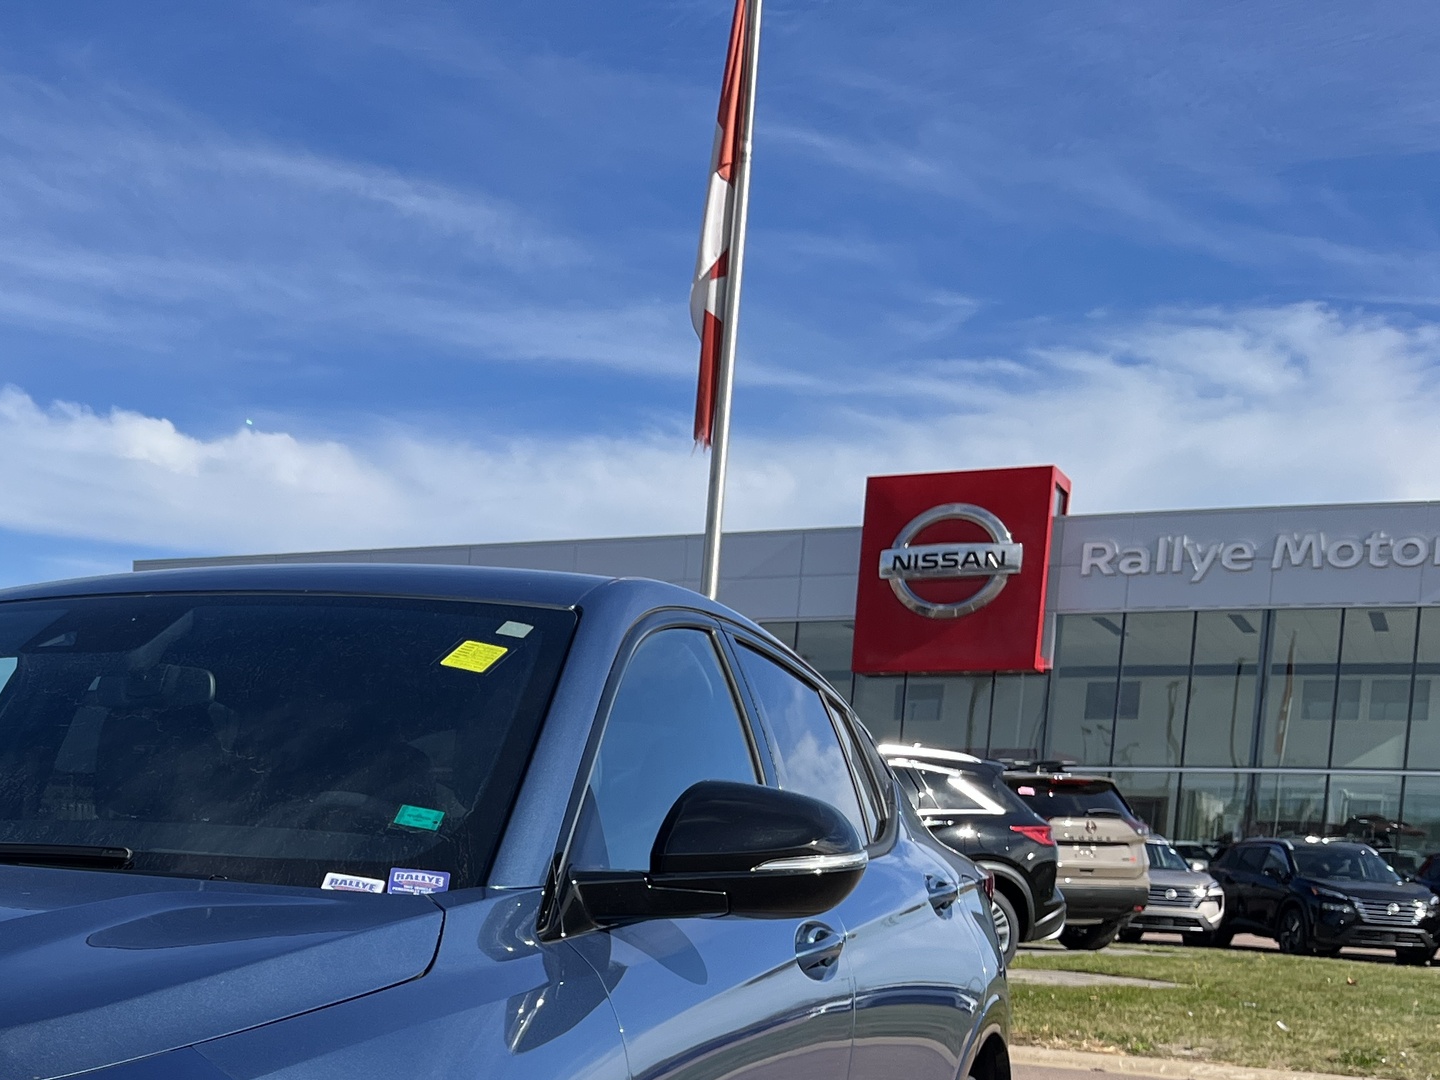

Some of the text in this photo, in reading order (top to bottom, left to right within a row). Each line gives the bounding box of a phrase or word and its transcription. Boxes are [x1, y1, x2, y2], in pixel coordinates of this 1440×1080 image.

[892, 550, 1006, 571] NISSAN
[1080, 535, 1256, 583] Rallye
[329, 878, 377, 893] RALLYE
[395, 873, 443, 886] RALLYE
